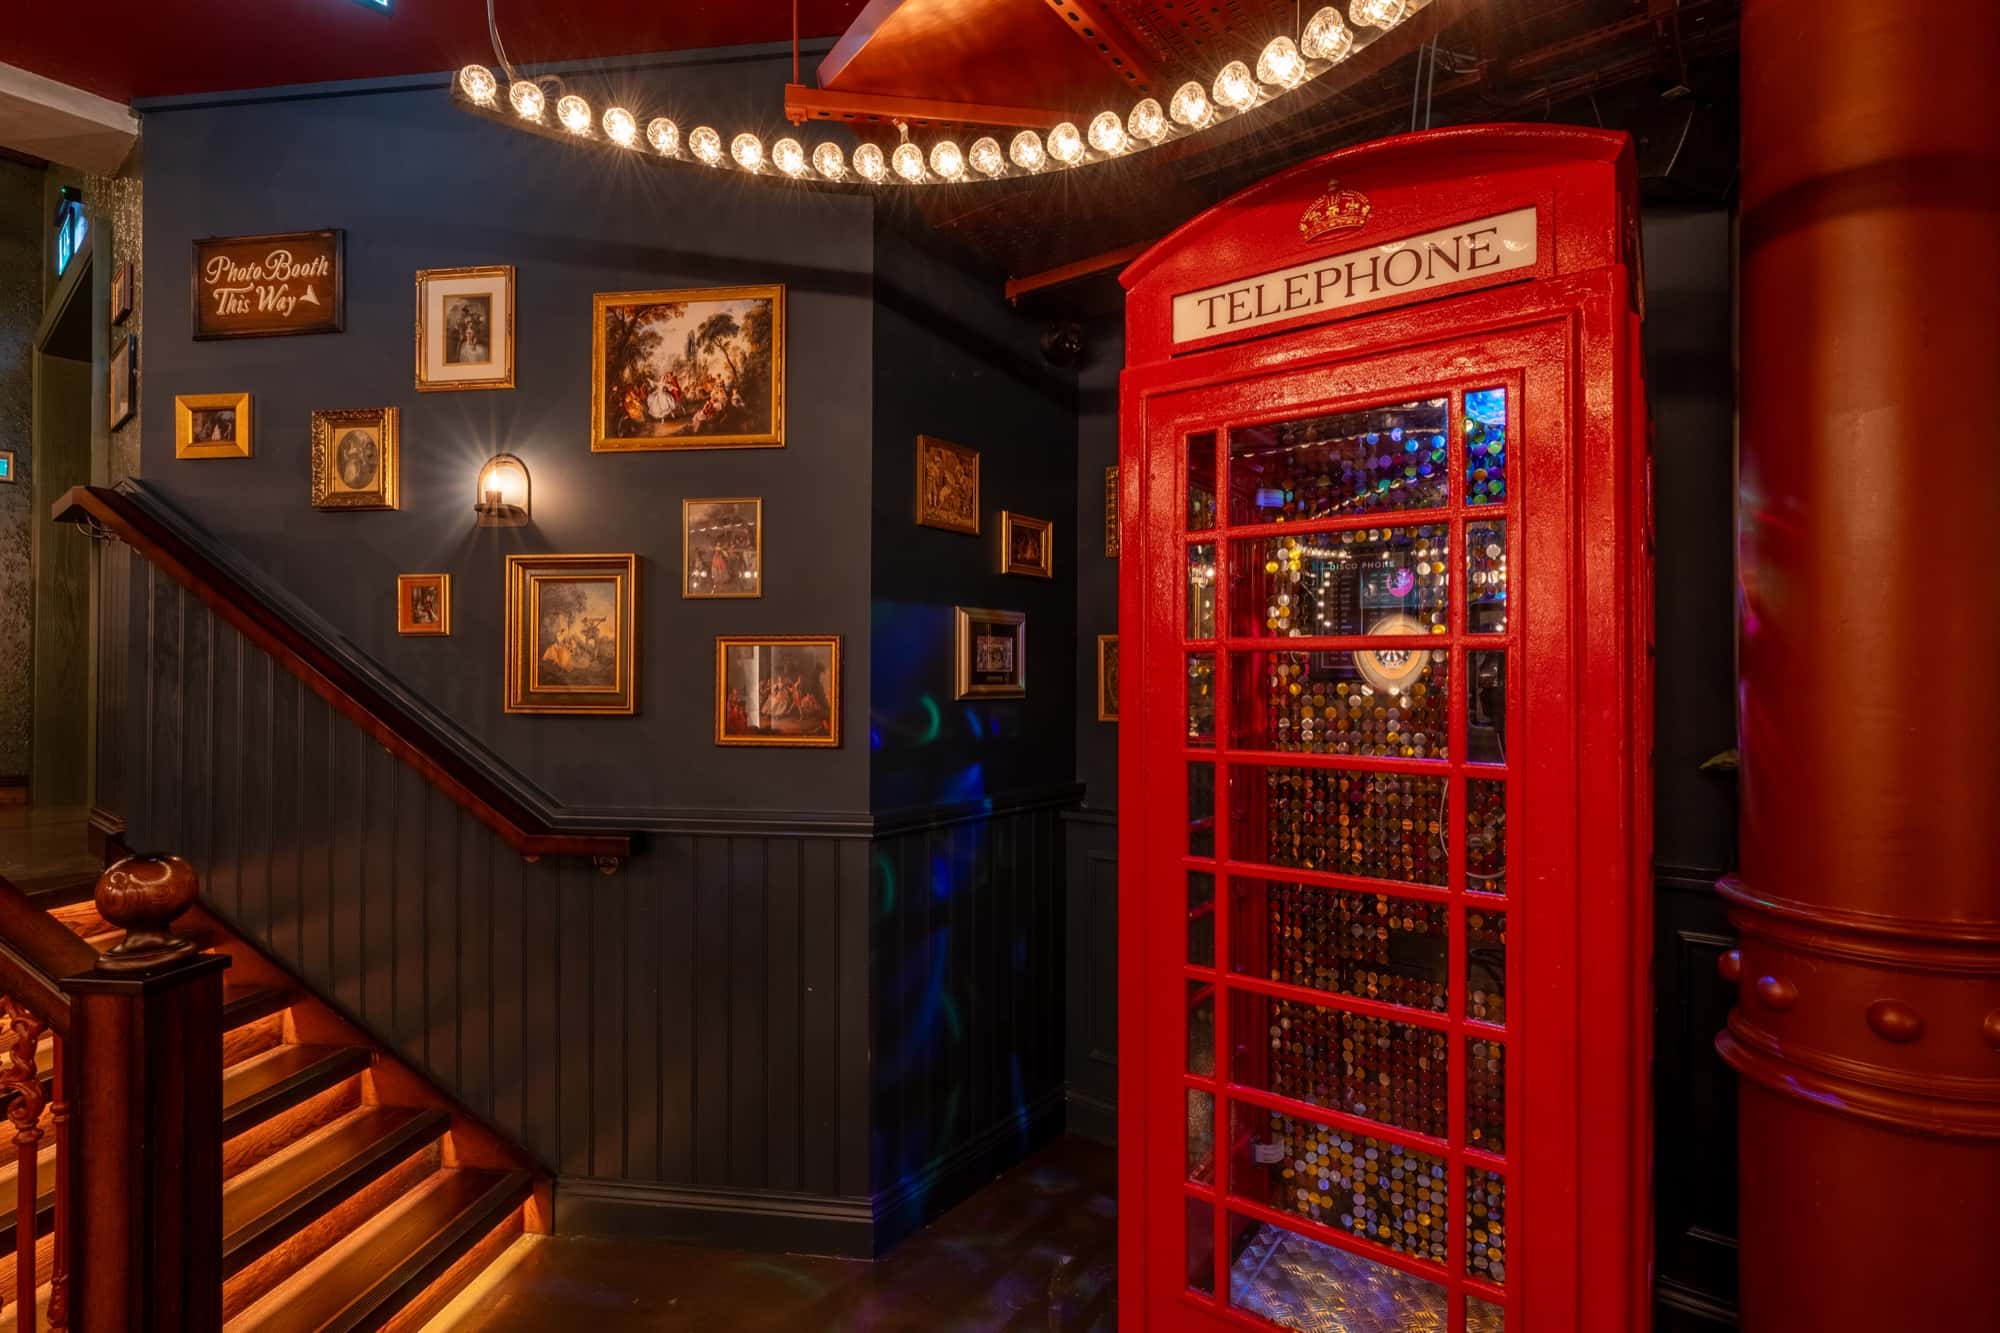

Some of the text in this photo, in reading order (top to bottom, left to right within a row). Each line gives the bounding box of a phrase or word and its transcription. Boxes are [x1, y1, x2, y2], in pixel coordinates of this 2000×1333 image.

[204, 249, 329, 284] Photo Booth
[1197, 226, 1501, 330] TELEPHONE
[213, 282, 297, 318] This Way
